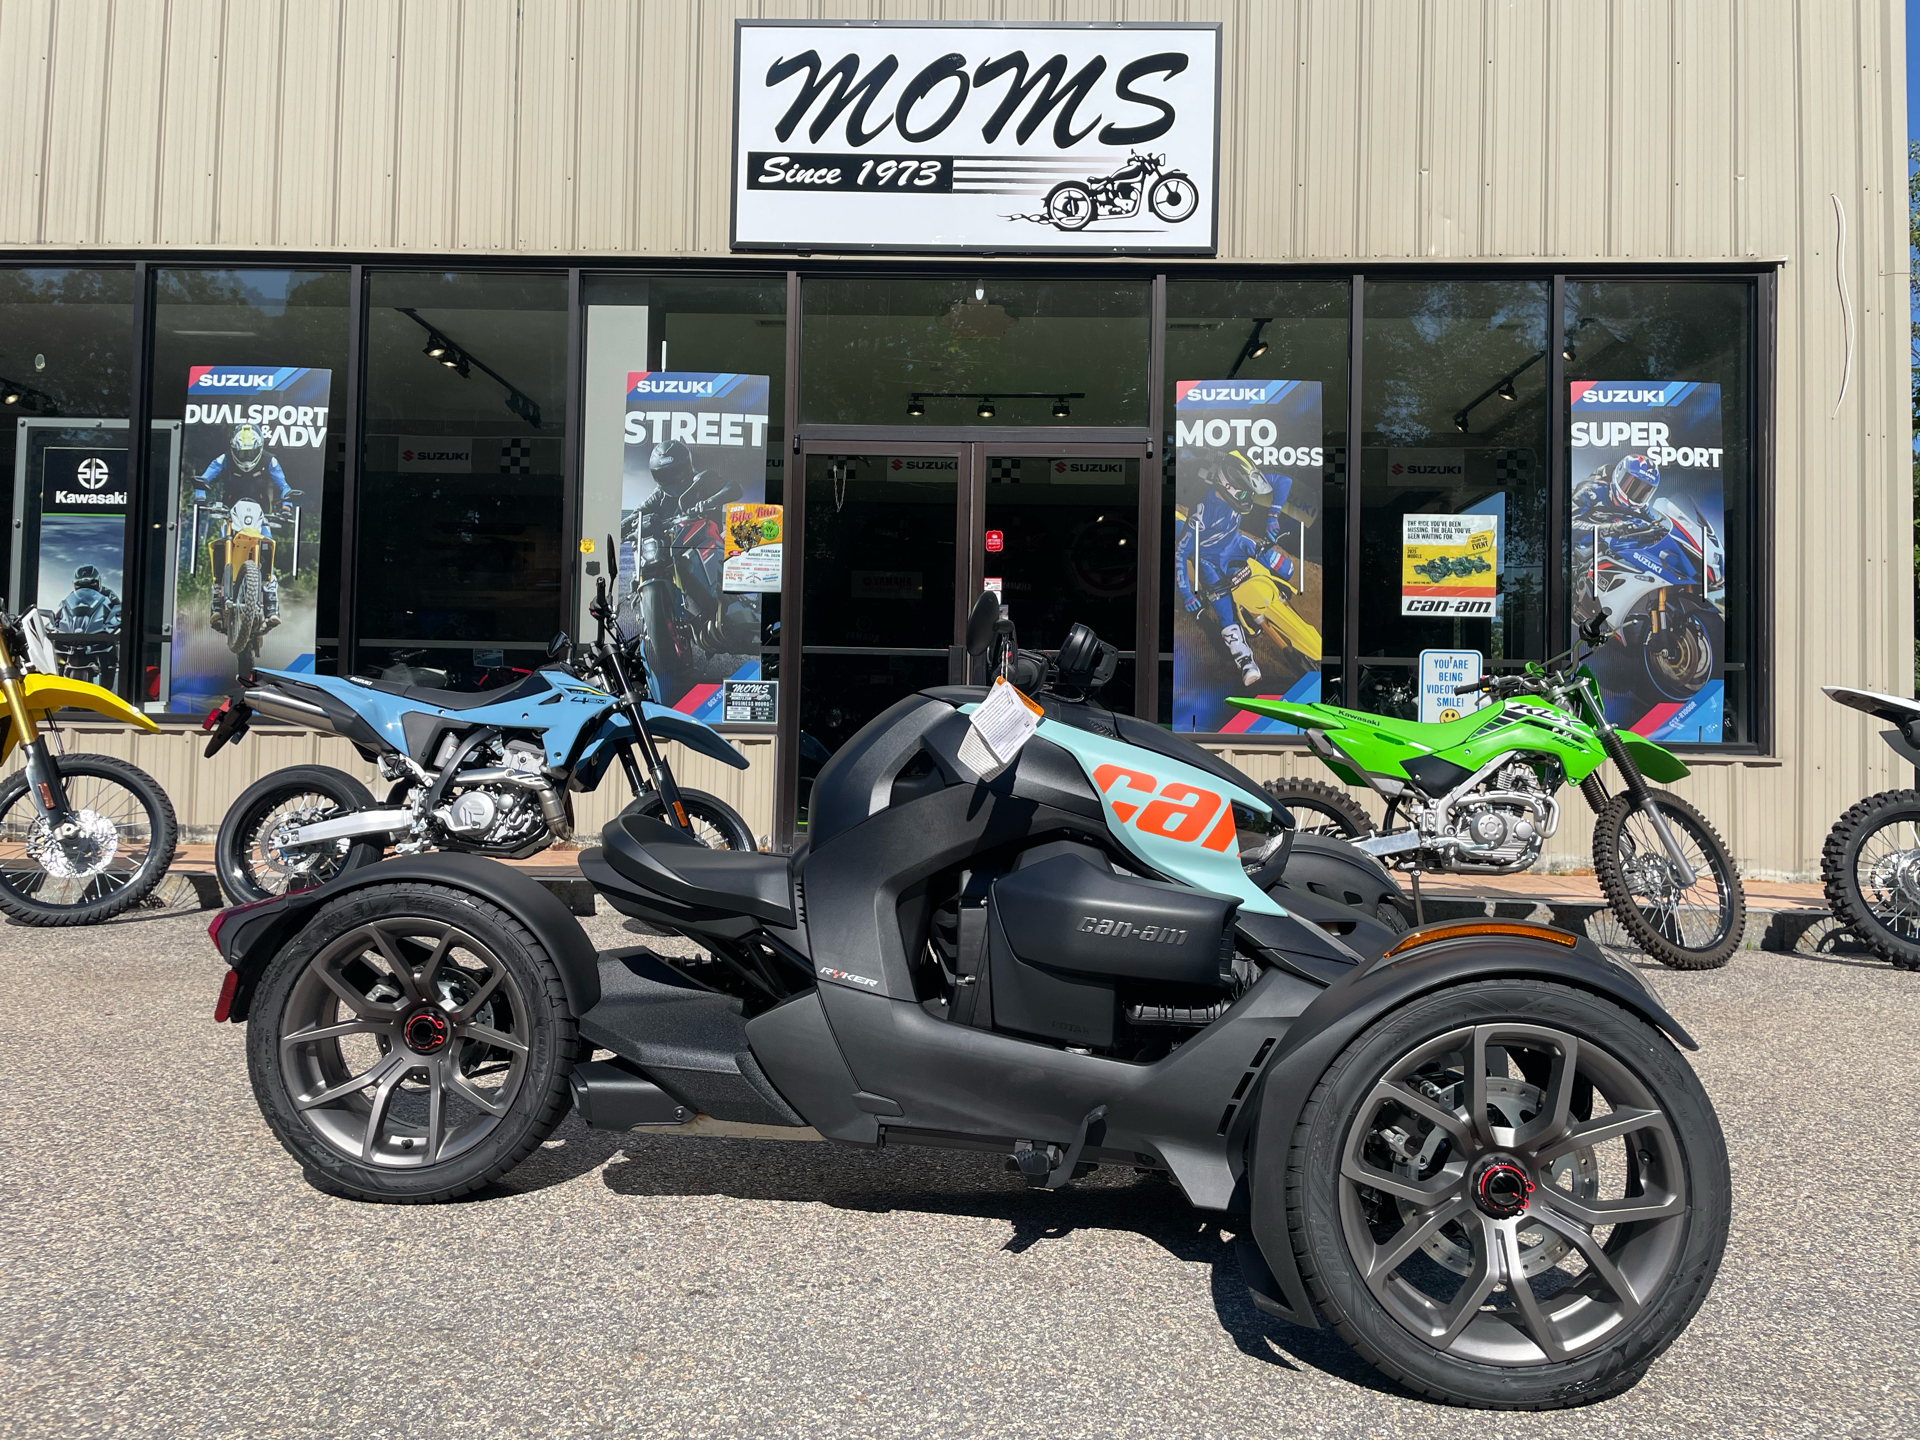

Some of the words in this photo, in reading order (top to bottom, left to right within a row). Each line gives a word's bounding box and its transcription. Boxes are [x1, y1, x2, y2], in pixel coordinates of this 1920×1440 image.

[765, 49, 1189, 149] MOMS
[758, 156, 842, 185] Since
[856, 159, 941, 186] 1973
[199, 374, 274, 388] SUZUKI
[636, 379, 713, 394] SUZUKI
[1187, 388, 1266, 401] SUZUKI
[1582, 390, 1664, 403] SUZUKI
[185, 404, 329, 427] DUALSPORT
[261, 425, 327, 448] &ADV
[624, 411, 769, 447] STREET
[1176, 419, 1277, 447] MOTO
[1571, 422, 1669, 447] SUPER
[417, 450, 469, 461] SUZUKI
[1247, 446, 1323, 467] CROSS
[1647, 447, 1723, 468] SPORT
[906, 461, 958, 470] SUZUKI
[1070, 463, 1123, 473] SUZUKI
[1407, 465, 1462, 475] SUZUKI
[55, 490, 127, 505] Kawasaki
[729, 511, 753, 523] Bike
[1472, 540, 1488, 551] EVENT
[1633, 552, 1663, 574] SUZUKI
[874, 576, 912, 587] YAMAHA
[1406, 600, 1492, 613] can-am
[1434, 659, 1450, 669] YOU
[1452, 660, 1468, 670] ARE
[1438, 672, 1463, 682] BEING
[732, 684, 770, 694] MOMS
[1436, 698, 1464, 708] SMILE!
[1338, 710, 1380, 726] Kawasaki
[1508, 704, 1587, 727] KLX
[1076, 916, 1189, 946] can-am
[820, 966, 878, 987] RYKER
[1316, 1222, 1349, 1284] KENDA
